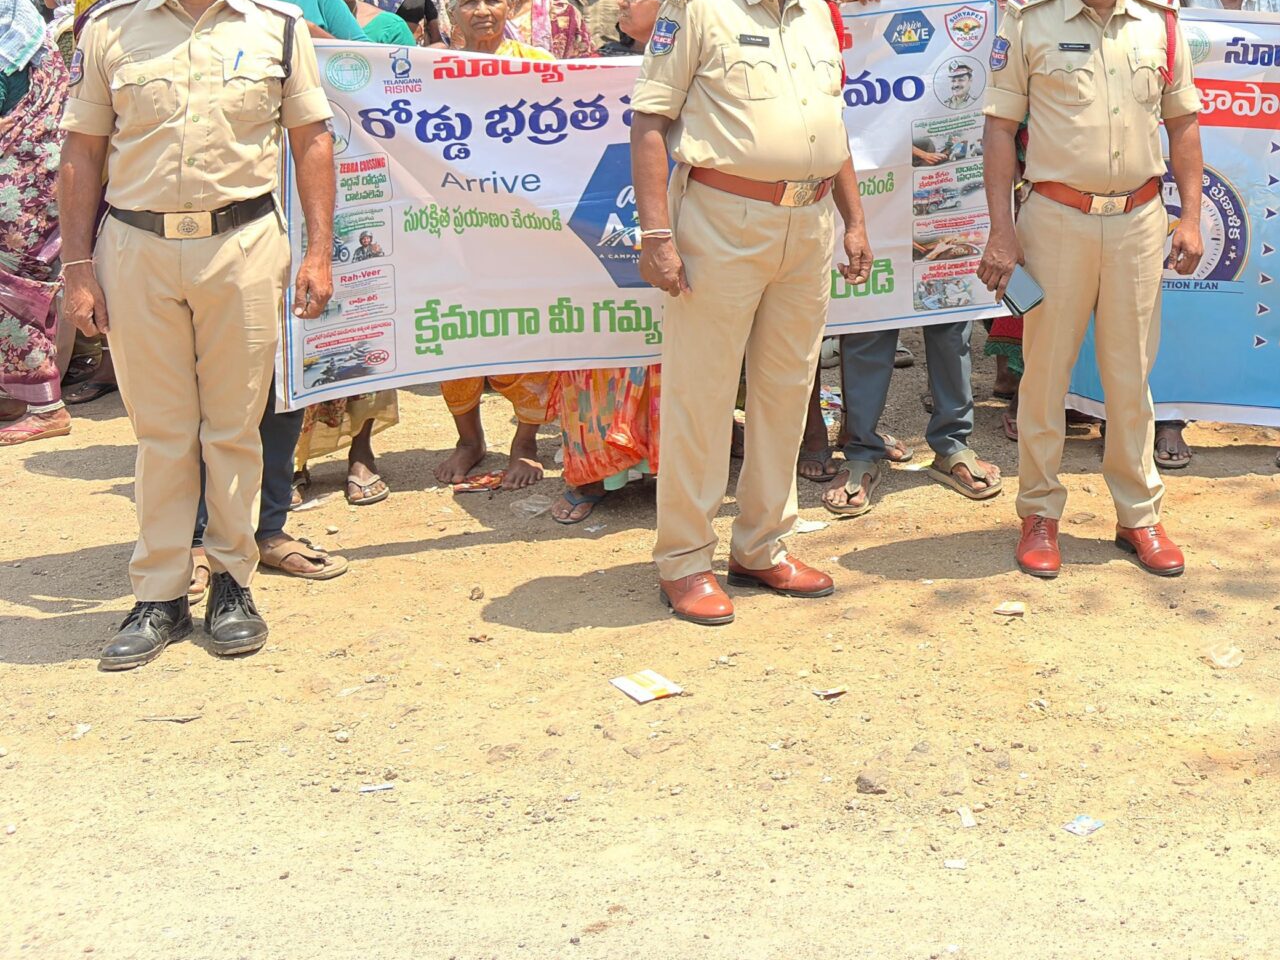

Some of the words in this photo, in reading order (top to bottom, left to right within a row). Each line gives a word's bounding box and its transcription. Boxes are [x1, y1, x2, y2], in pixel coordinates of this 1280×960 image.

[949, 11, 984, 24] SURYAPET
[385, 84, 422, 94] RISING
[357, 99, 472, 161] రోడ్డు
[485, 95, 609, 145] భద్రత
[441, 171, 541, 193] Arrive
[404, 203, 450, 238] సురక్షిత
[453, 205, 508, 234] ప్రయాణం
[512, 208, 562, 231] చేయండి
[340, 269, 381, 283] Rah-Veer
[1162, 280, 1190, 290] CTION
[1193, 281, 1219, 290] PLAN
[414, 299, 540, 355] క్షేమంగా
[549, 297, 585, 333] మీ
